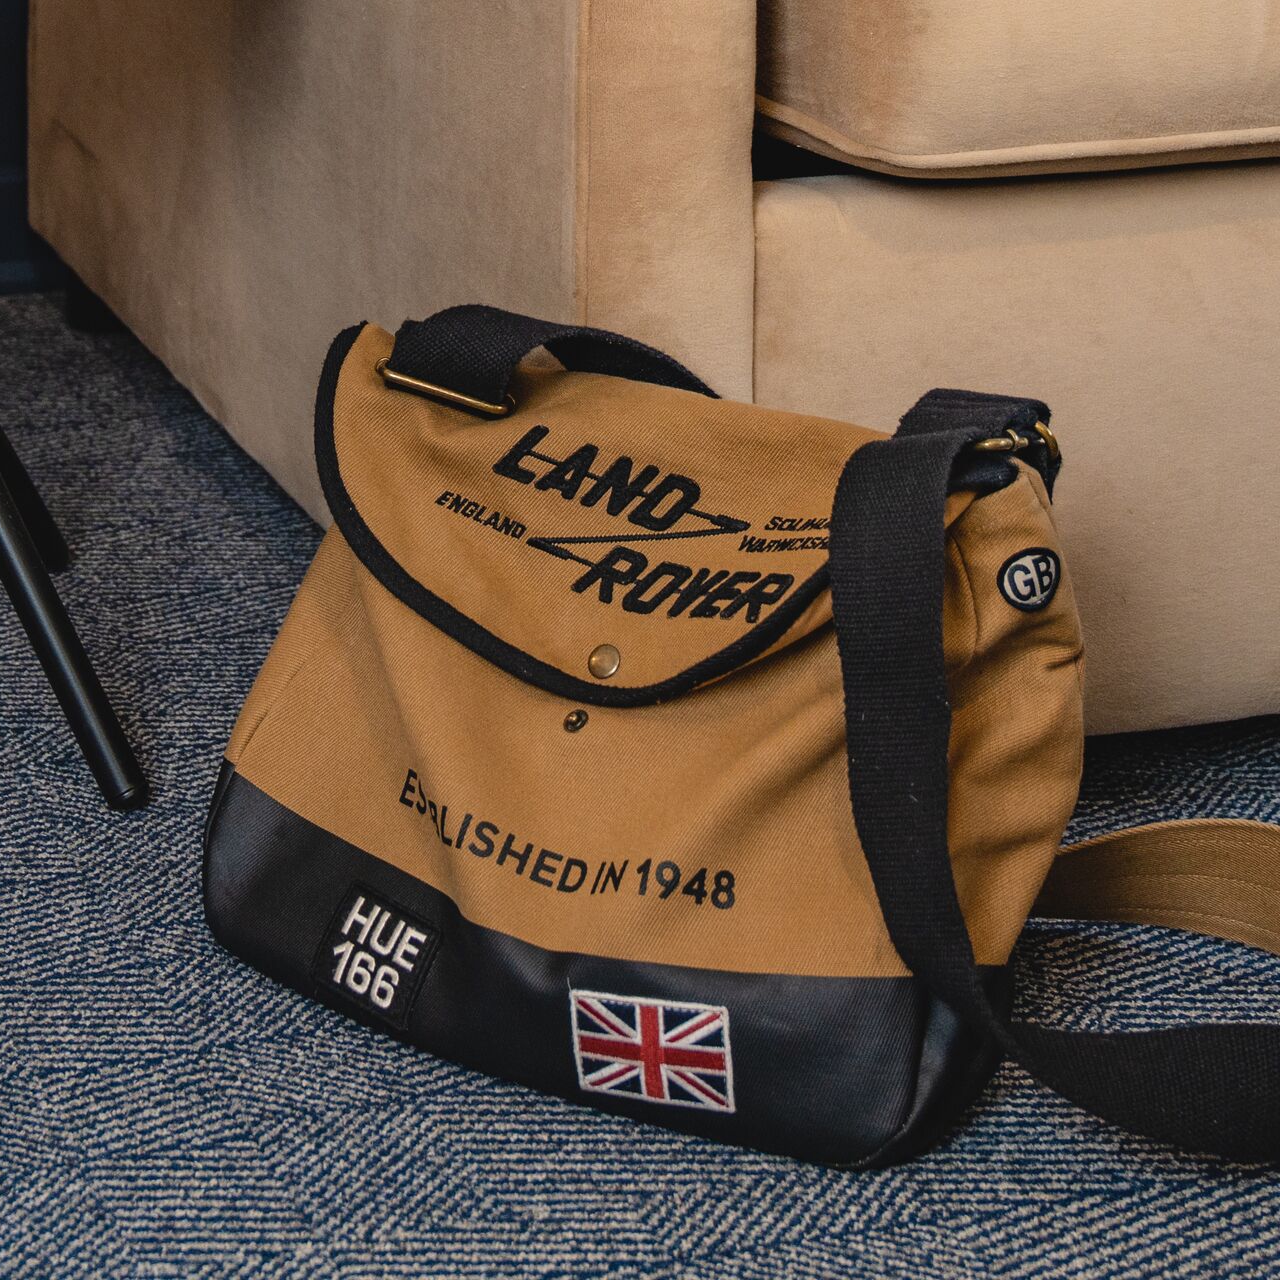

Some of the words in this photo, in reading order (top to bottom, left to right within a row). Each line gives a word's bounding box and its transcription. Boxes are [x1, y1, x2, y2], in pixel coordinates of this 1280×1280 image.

[492, 424, 701, 531] LAND
[435, 491, 526, 539] ENGLAND
[571, 546, 795, 623] ROVER
[1008, 555, 1054, 601] GB
[590, 859, 629, 895] IN
[636, 858, 735, 910] 1948
[341, 896, 427, 972] HUE
[333, 940, 400, 1008] 166
